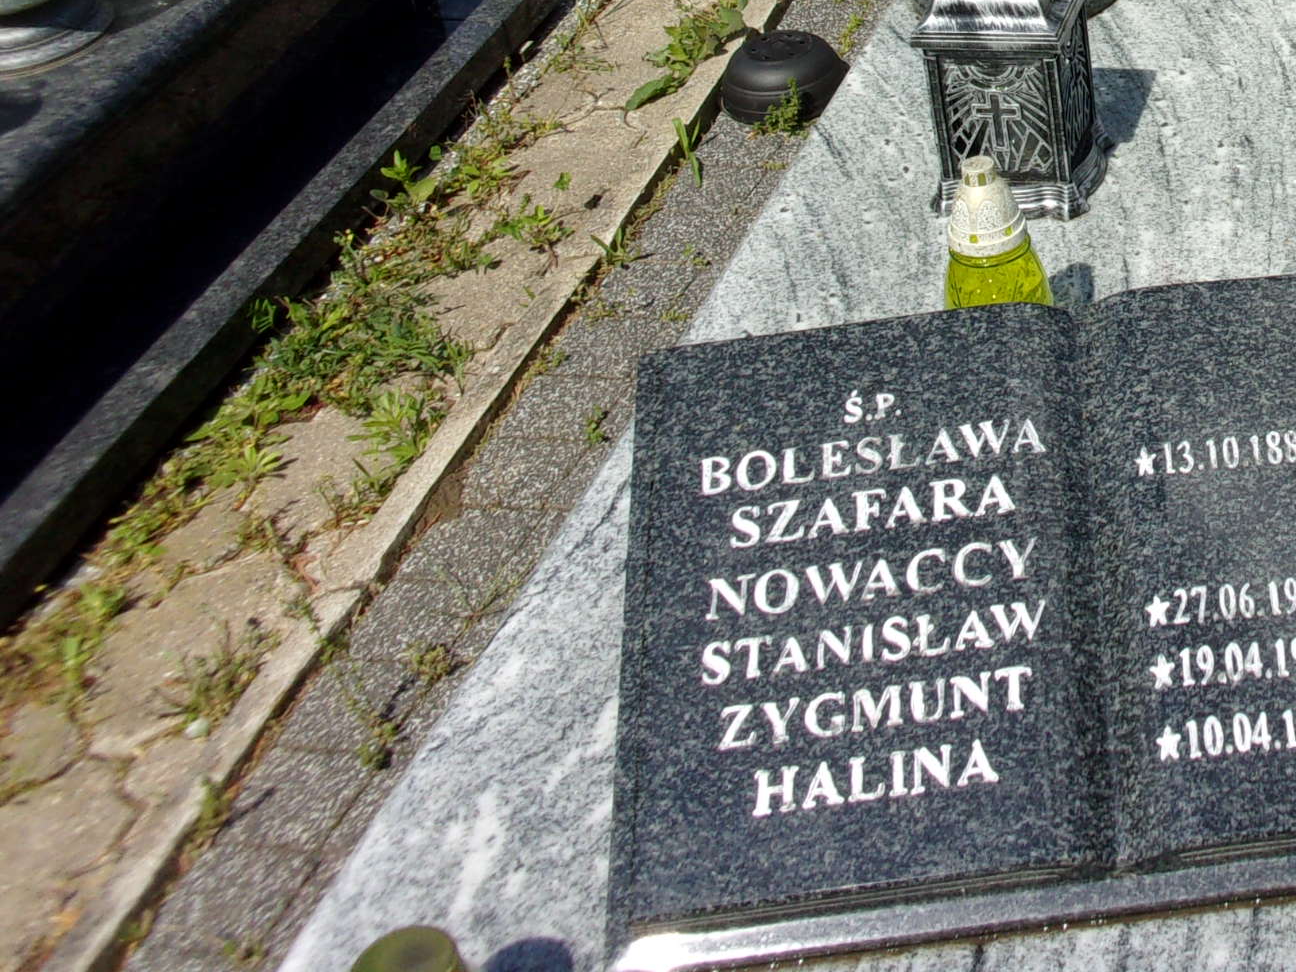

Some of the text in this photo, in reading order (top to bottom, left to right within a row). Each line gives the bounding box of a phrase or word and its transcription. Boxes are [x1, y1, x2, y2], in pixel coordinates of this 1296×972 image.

[844, 389, 902, 424] Ś.P.
[702, 418, 1047, 495] BOLESŁAWA
[730, 474, 1016, 548] SZAFARA
[705, 537, 1038, 621] NOWACCY
[702, 599, 1046, 685] STANISŁAW
[717, 665, 1032, 752] ZYGMUNT
[752, 739, 999, 817] HALINA
